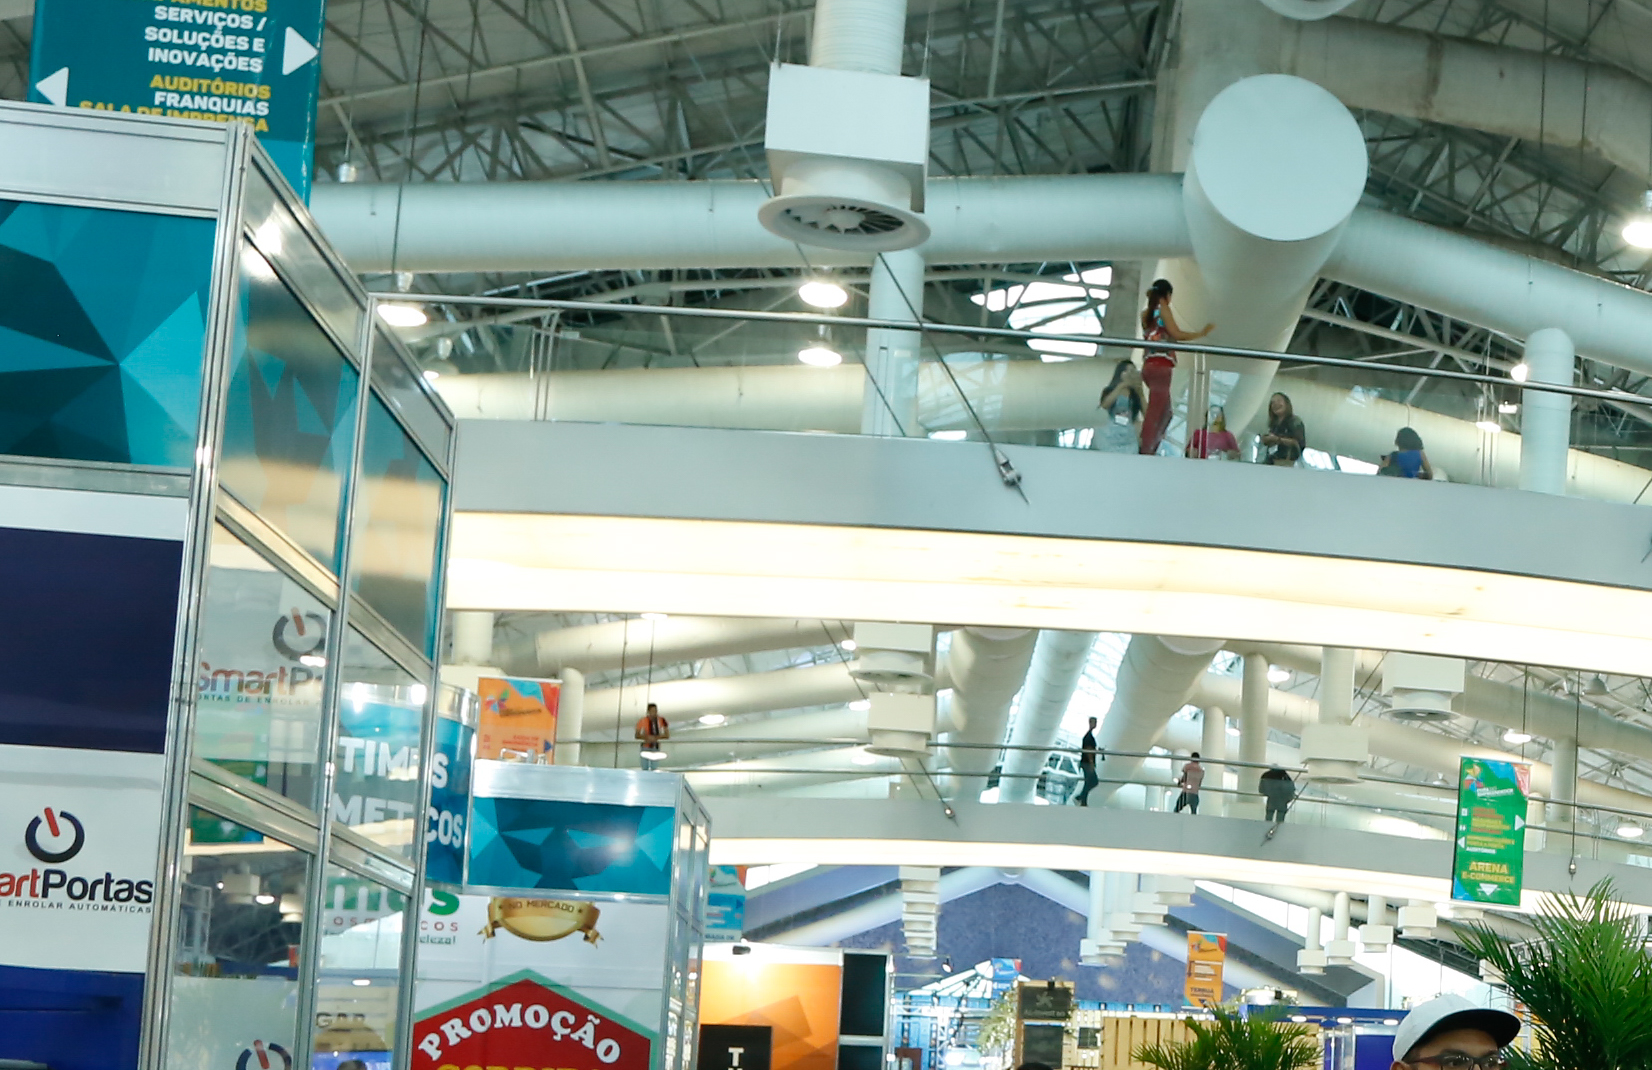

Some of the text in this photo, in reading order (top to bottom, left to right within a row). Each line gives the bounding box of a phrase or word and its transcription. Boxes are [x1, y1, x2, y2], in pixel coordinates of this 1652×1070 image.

[154, 5, 267, 31] SERVIÇOS /
[144, 26, 265, 52] SOLUÇÕES E
[147, 47, 263, 73] INOVAÇÕES
[150, 74, 271, 99] AUDITÓRIOS
[154, 91, 269, 116] FRANQUIAS
[198, 662, 323, 697] SmartP
[1469, 861, 1509, 875] ARENA
[8, 900, 152, 914] ENROLAR AUTOMÁTICAS
[526, 900, 576, 914] MERCADO
[418, 1003, 621, 1064] PROMOÇÃO
